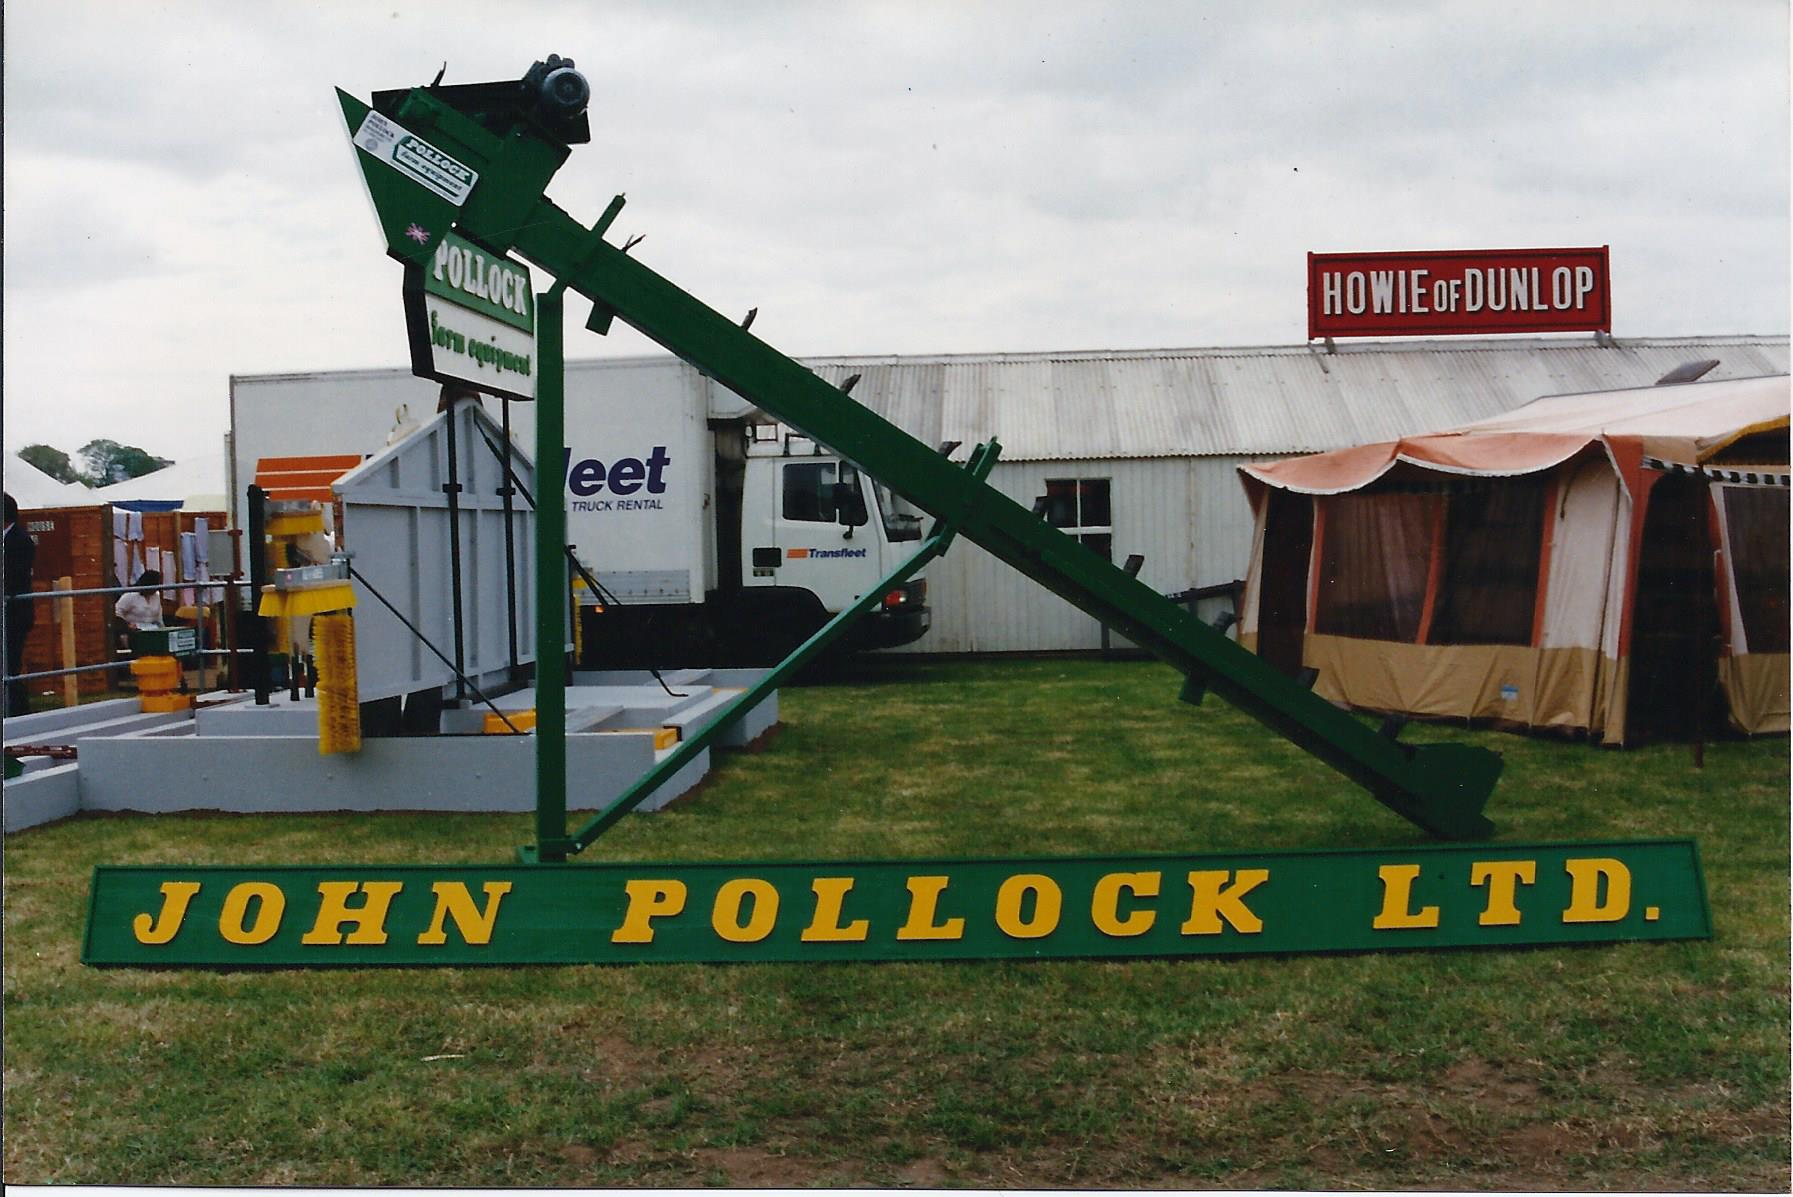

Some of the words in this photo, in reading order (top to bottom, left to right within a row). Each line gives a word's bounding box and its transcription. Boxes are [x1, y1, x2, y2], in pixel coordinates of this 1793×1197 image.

[400, 151, 420, 166] farm
[421, 163, 463, 191] equipment
[405, 138, 471, 181] POLLOCK
[433, 239, 527, 316] POLLOCK
[1323, 270, 1430, 315] HOWIE
[1433, 279, 1462, 312] OF
[1464, 266, 1594, 312] DUNLOP
[431, 310, 465, 354] farm
[468, 335, 531, 377] equipment
[572, 501, 613, 512] TRUCK
[616, 499, 664, 511] RENTAL
[809, 547, 867, 559] Transfleet
[133, 881, 512, 945] JOHN
[611, 869, 1269, 943] POLLOCK
[1373, 858, 1660, 929] LTD.
